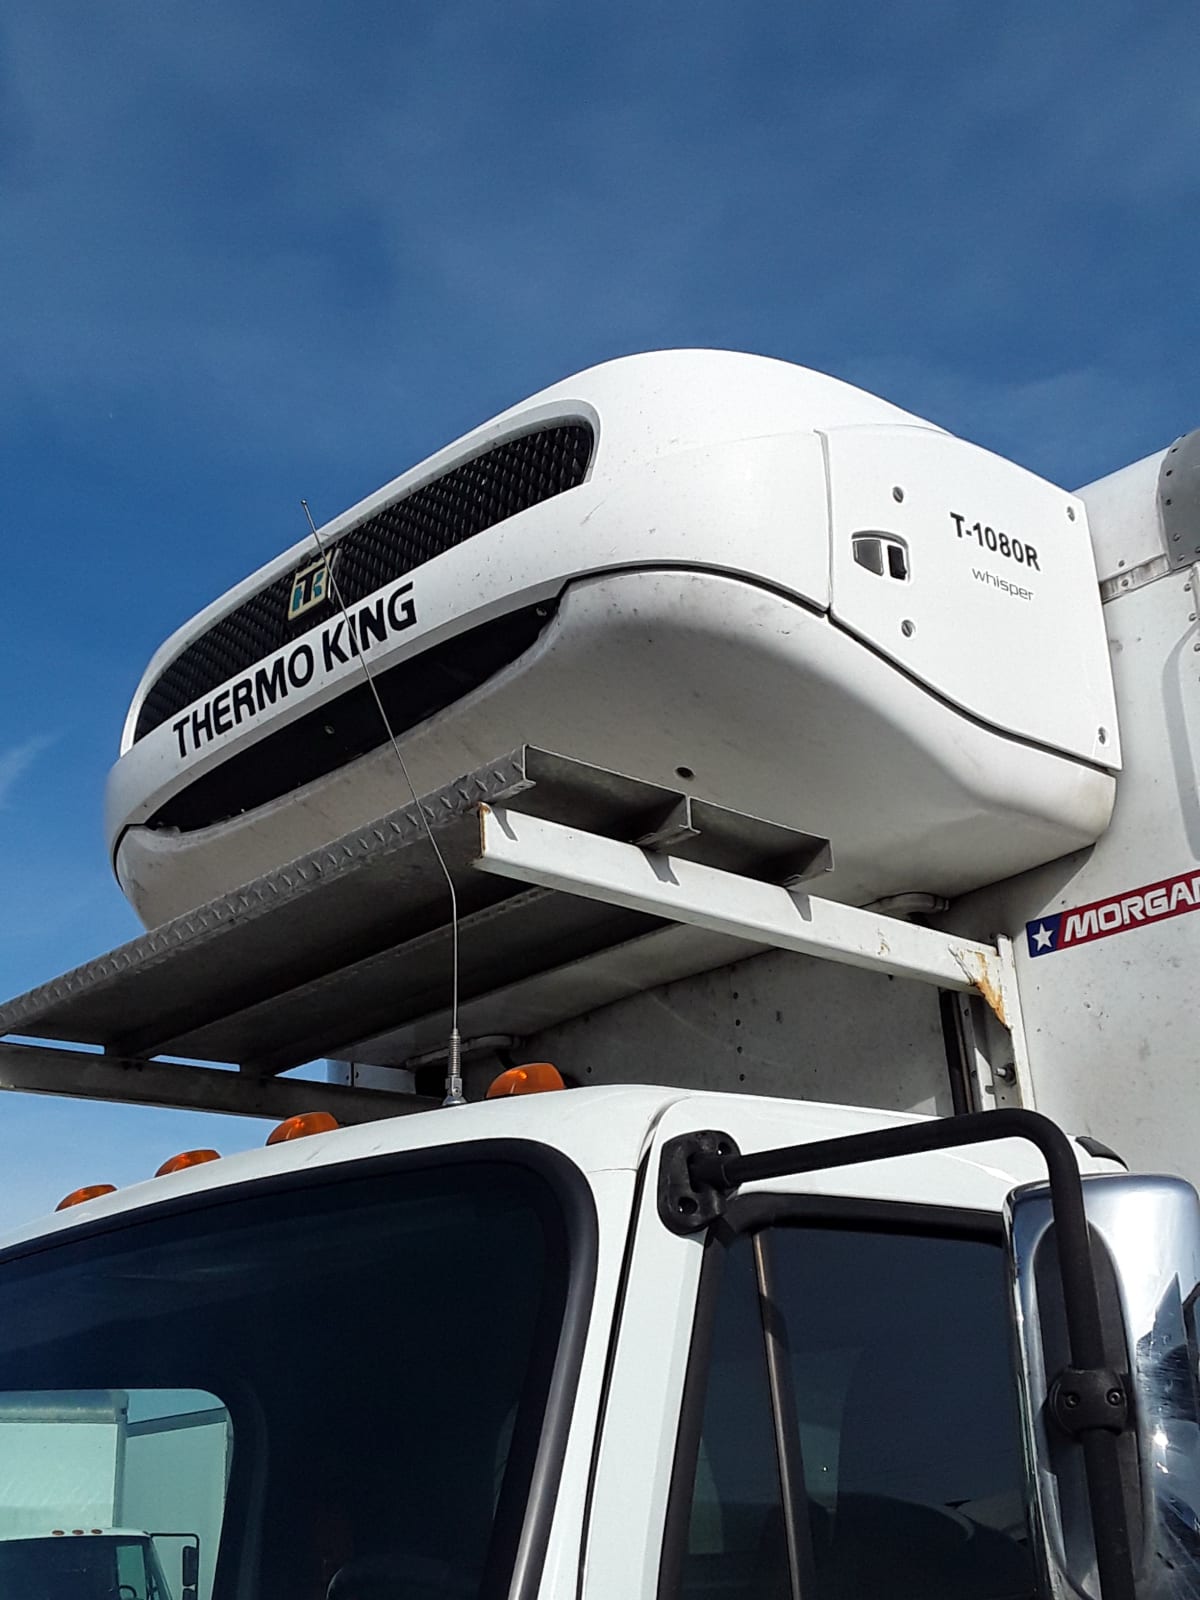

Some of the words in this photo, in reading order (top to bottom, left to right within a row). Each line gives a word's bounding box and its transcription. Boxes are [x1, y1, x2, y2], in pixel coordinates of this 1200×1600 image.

[949, 511, 1041, 572] T-1080R
[971, 567, 1034, 600] whisper
[172, 644, 315, 758] THERMO
[321, 580, 418, 673] KING
